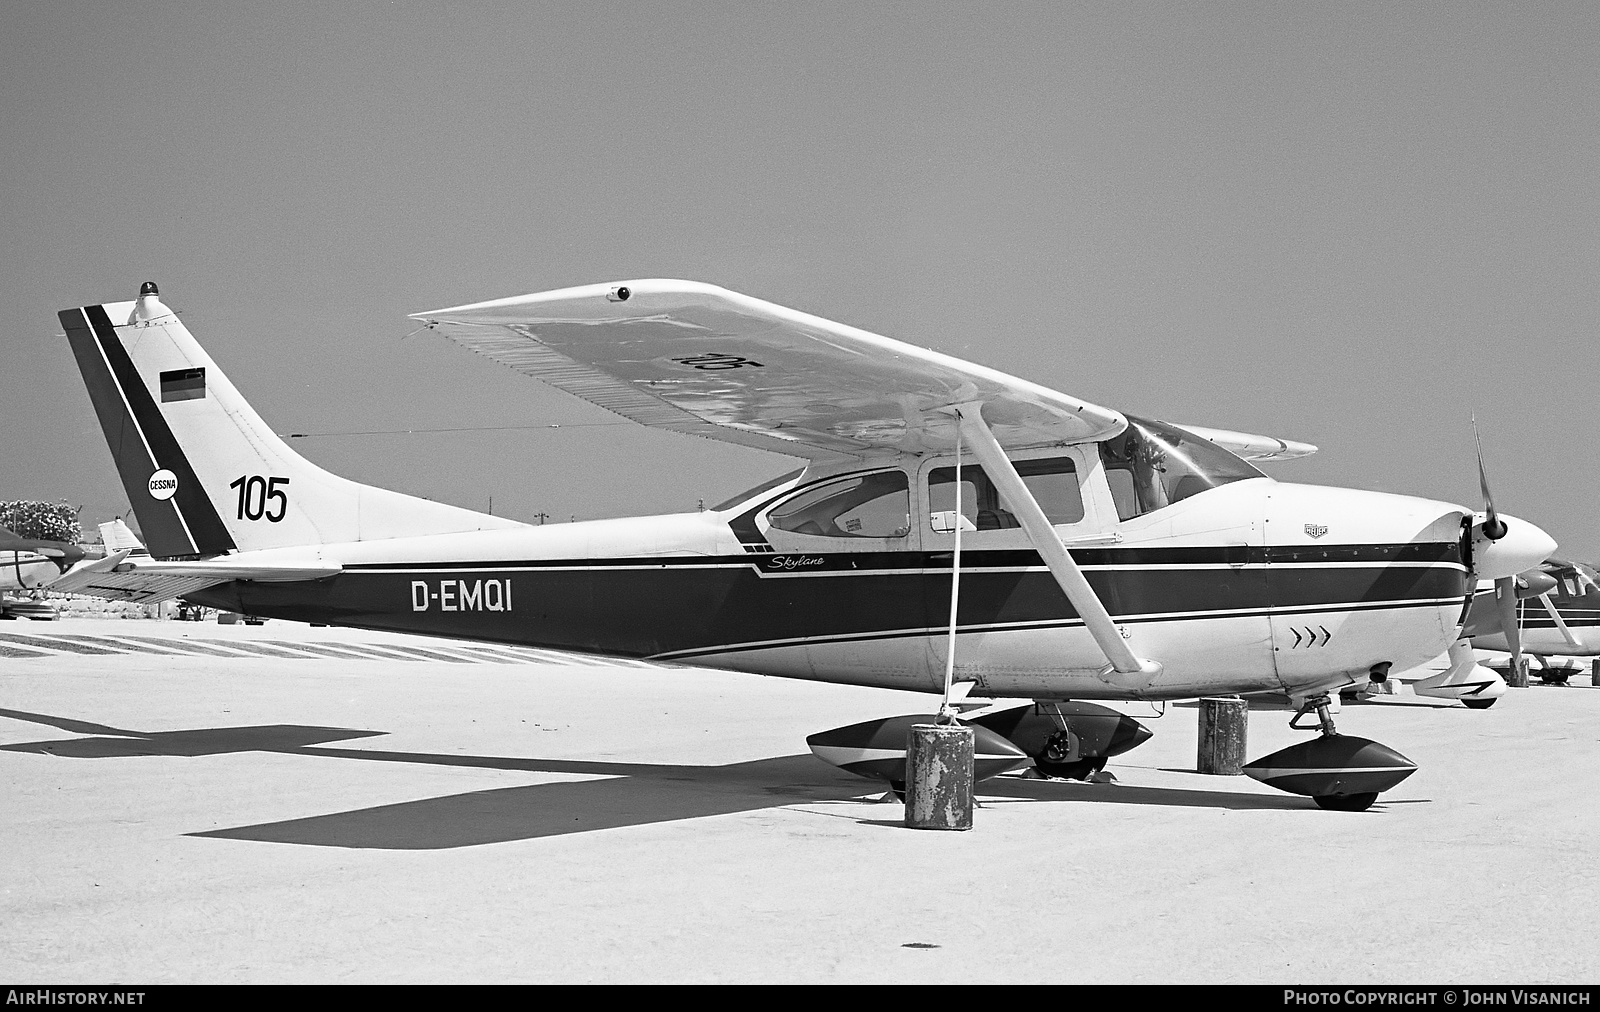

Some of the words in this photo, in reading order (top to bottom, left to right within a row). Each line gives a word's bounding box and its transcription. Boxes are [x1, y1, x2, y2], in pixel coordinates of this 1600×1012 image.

[150, 479, 176, 490] CESSNA
[230, 474, 290, 523] 105
[767, 555, 825, 570] Skylane
[411, 578, 512, 612] D-EMQI
